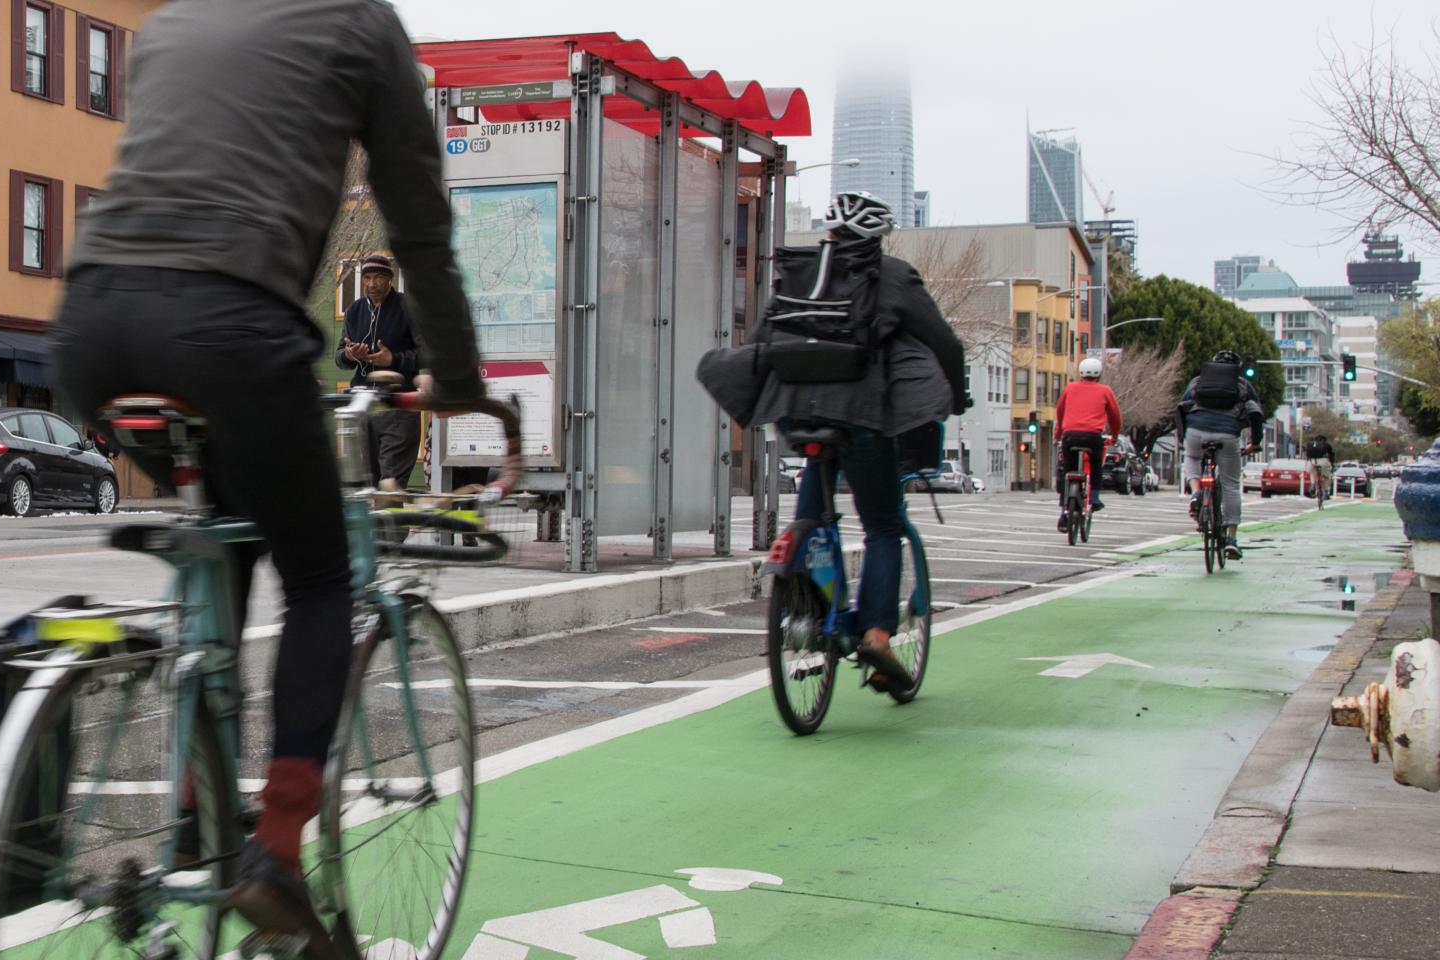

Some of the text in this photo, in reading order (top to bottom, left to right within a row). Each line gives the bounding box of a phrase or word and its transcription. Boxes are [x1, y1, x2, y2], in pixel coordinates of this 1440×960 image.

[481, 123, 501, 136] STOP
[503, 123, 510, 135] ID
[521, 120, 560, 133] 13192
[450, 139, 488, 153] 19 GGT
